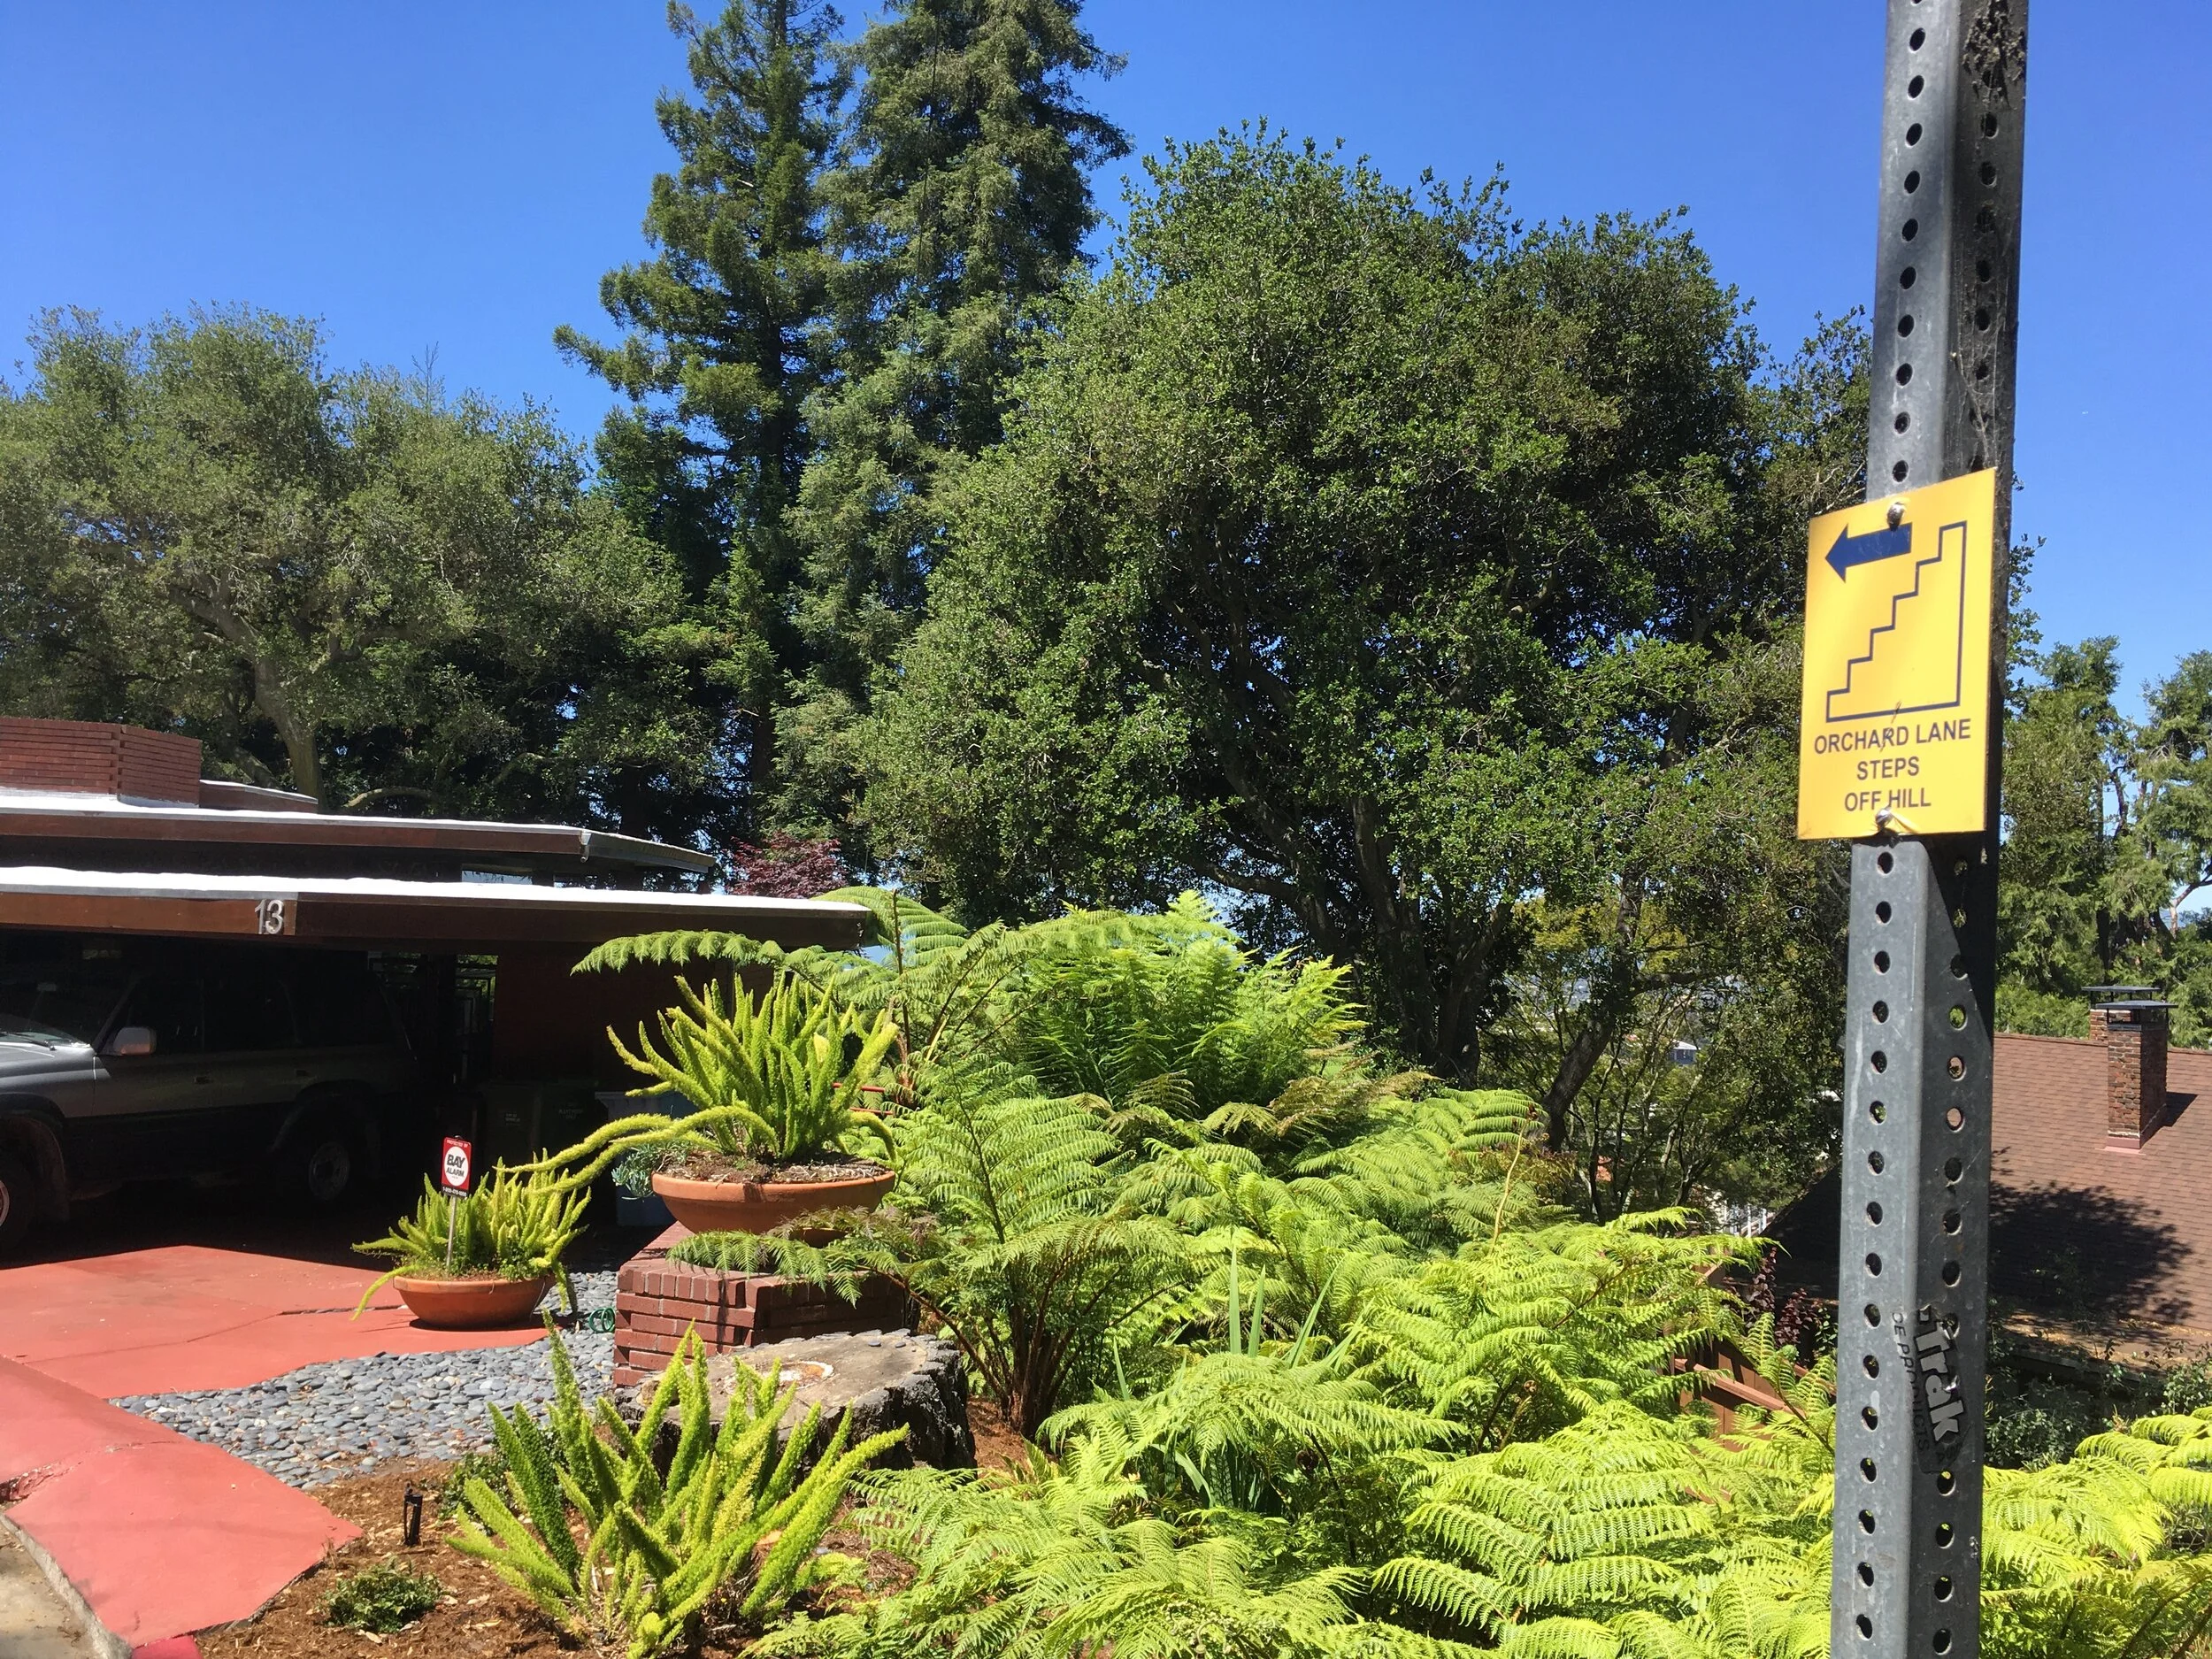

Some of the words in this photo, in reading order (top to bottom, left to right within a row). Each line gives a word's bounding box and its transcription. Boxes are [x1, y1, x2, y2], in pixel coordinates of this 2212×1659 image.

[1814, 726, 1909, 755] ORCHARD
[1916, 718, 1971, 744] LANE
[1856, 756, 1919, 780] STEPS
[1844, 790, 1881, 811] OFF
[1888, 787, 1932, 809] HILL
[255, 899, 284, 934] 13
[446, 1167, 465, 1178] ALARM
[447, 1154, 465, 1169] BAY
